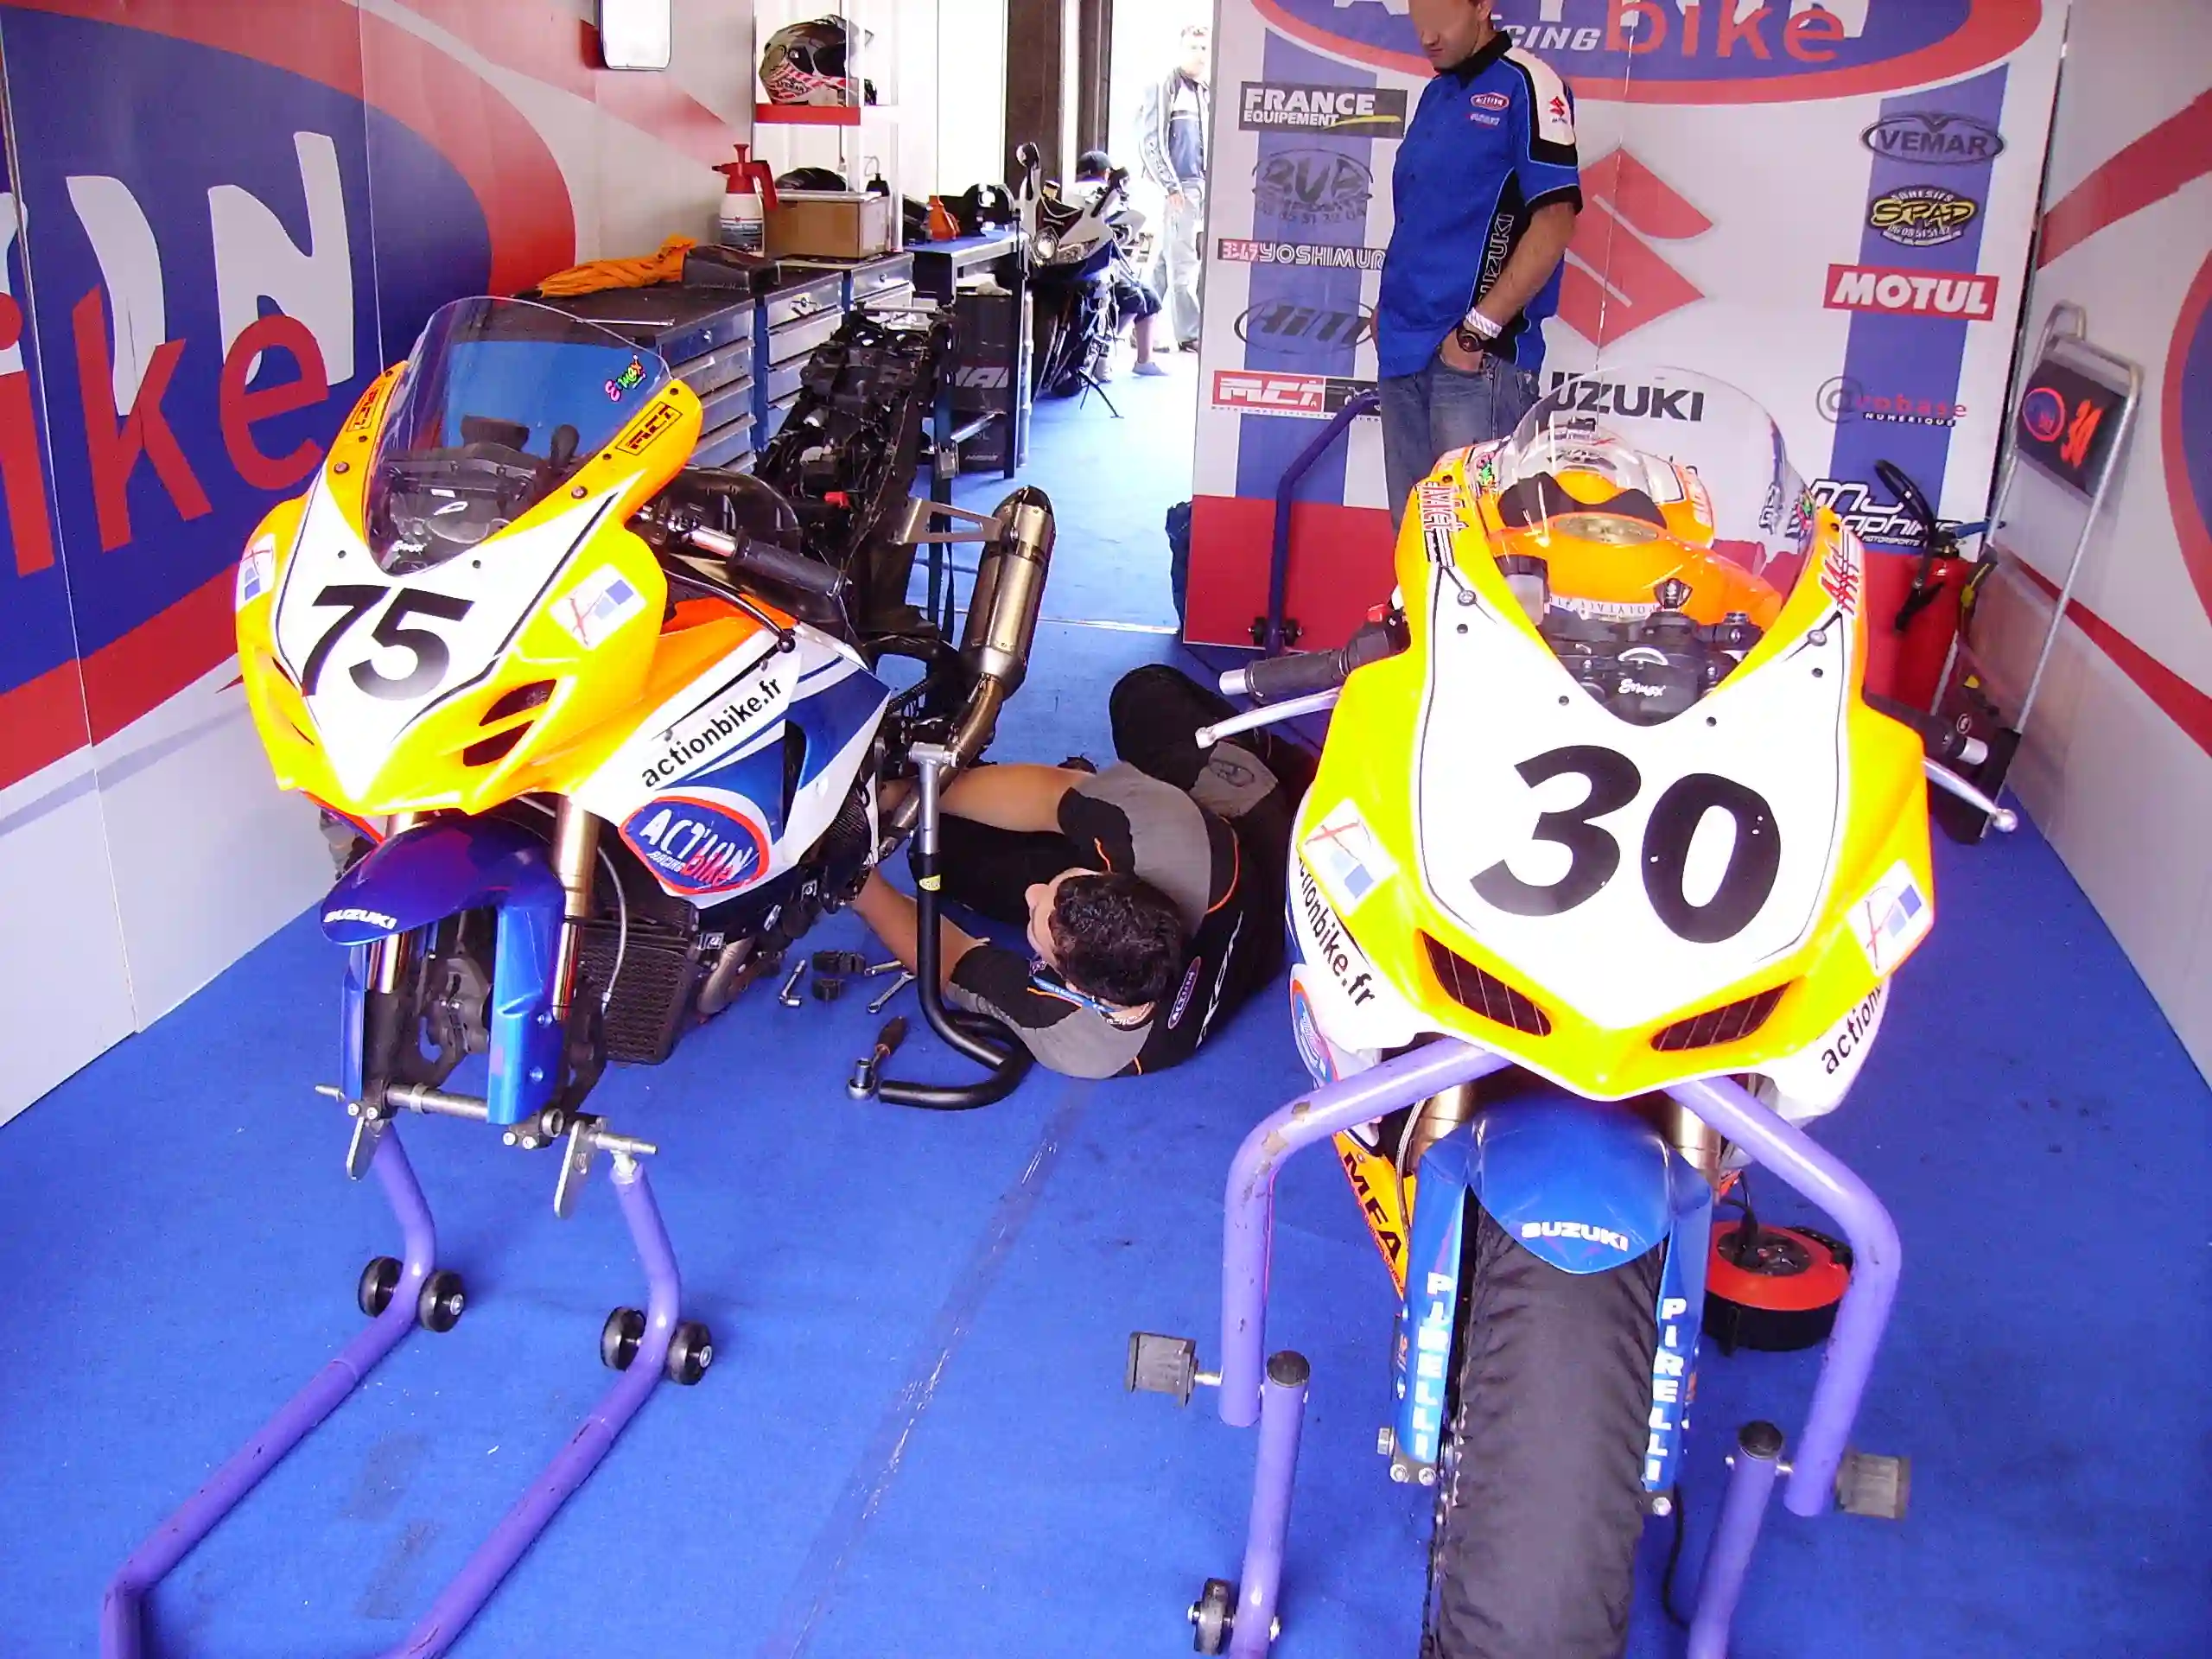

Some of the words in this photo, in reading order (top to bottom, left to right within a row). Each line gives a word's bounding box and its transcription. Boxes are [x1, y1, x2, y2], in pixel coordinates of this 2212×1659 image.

[1505, 25, 1602, 51] CING
[1605, 0, 1845, 62] bike
[1243, 109, 1340, 127] EQUIPEMENT
[1245, 87, 1376, 117] FRANCE
[1879, 130, 1988, 156] VEMAR
[1871, 199, 1975, 230] SPAD
[1259, 241, 1387, 270] YOSHIMUR
[1478, 213, 1514, 302] UZUKI
[1831, 271, 1988, 315] MOTUL
[1551, 372, 1705, 423] UZUKI
[0, 283, 330, 577] ike
[1865, 411, 1955, 428] NUMERIQUE
[1862, 536, 1921, 547] MOTORSPORTS
[301, 584, 476, 702] 75
[641, 678, 782, 788] actionbike.fr
[1468, 744, 1782, 944] 30
[322, 908, 397, 931] SUZUKI
[1521, 1220, 1629, 1252] SUZUKI
[1645, 1297, 1687, 1483] PIRELLI
